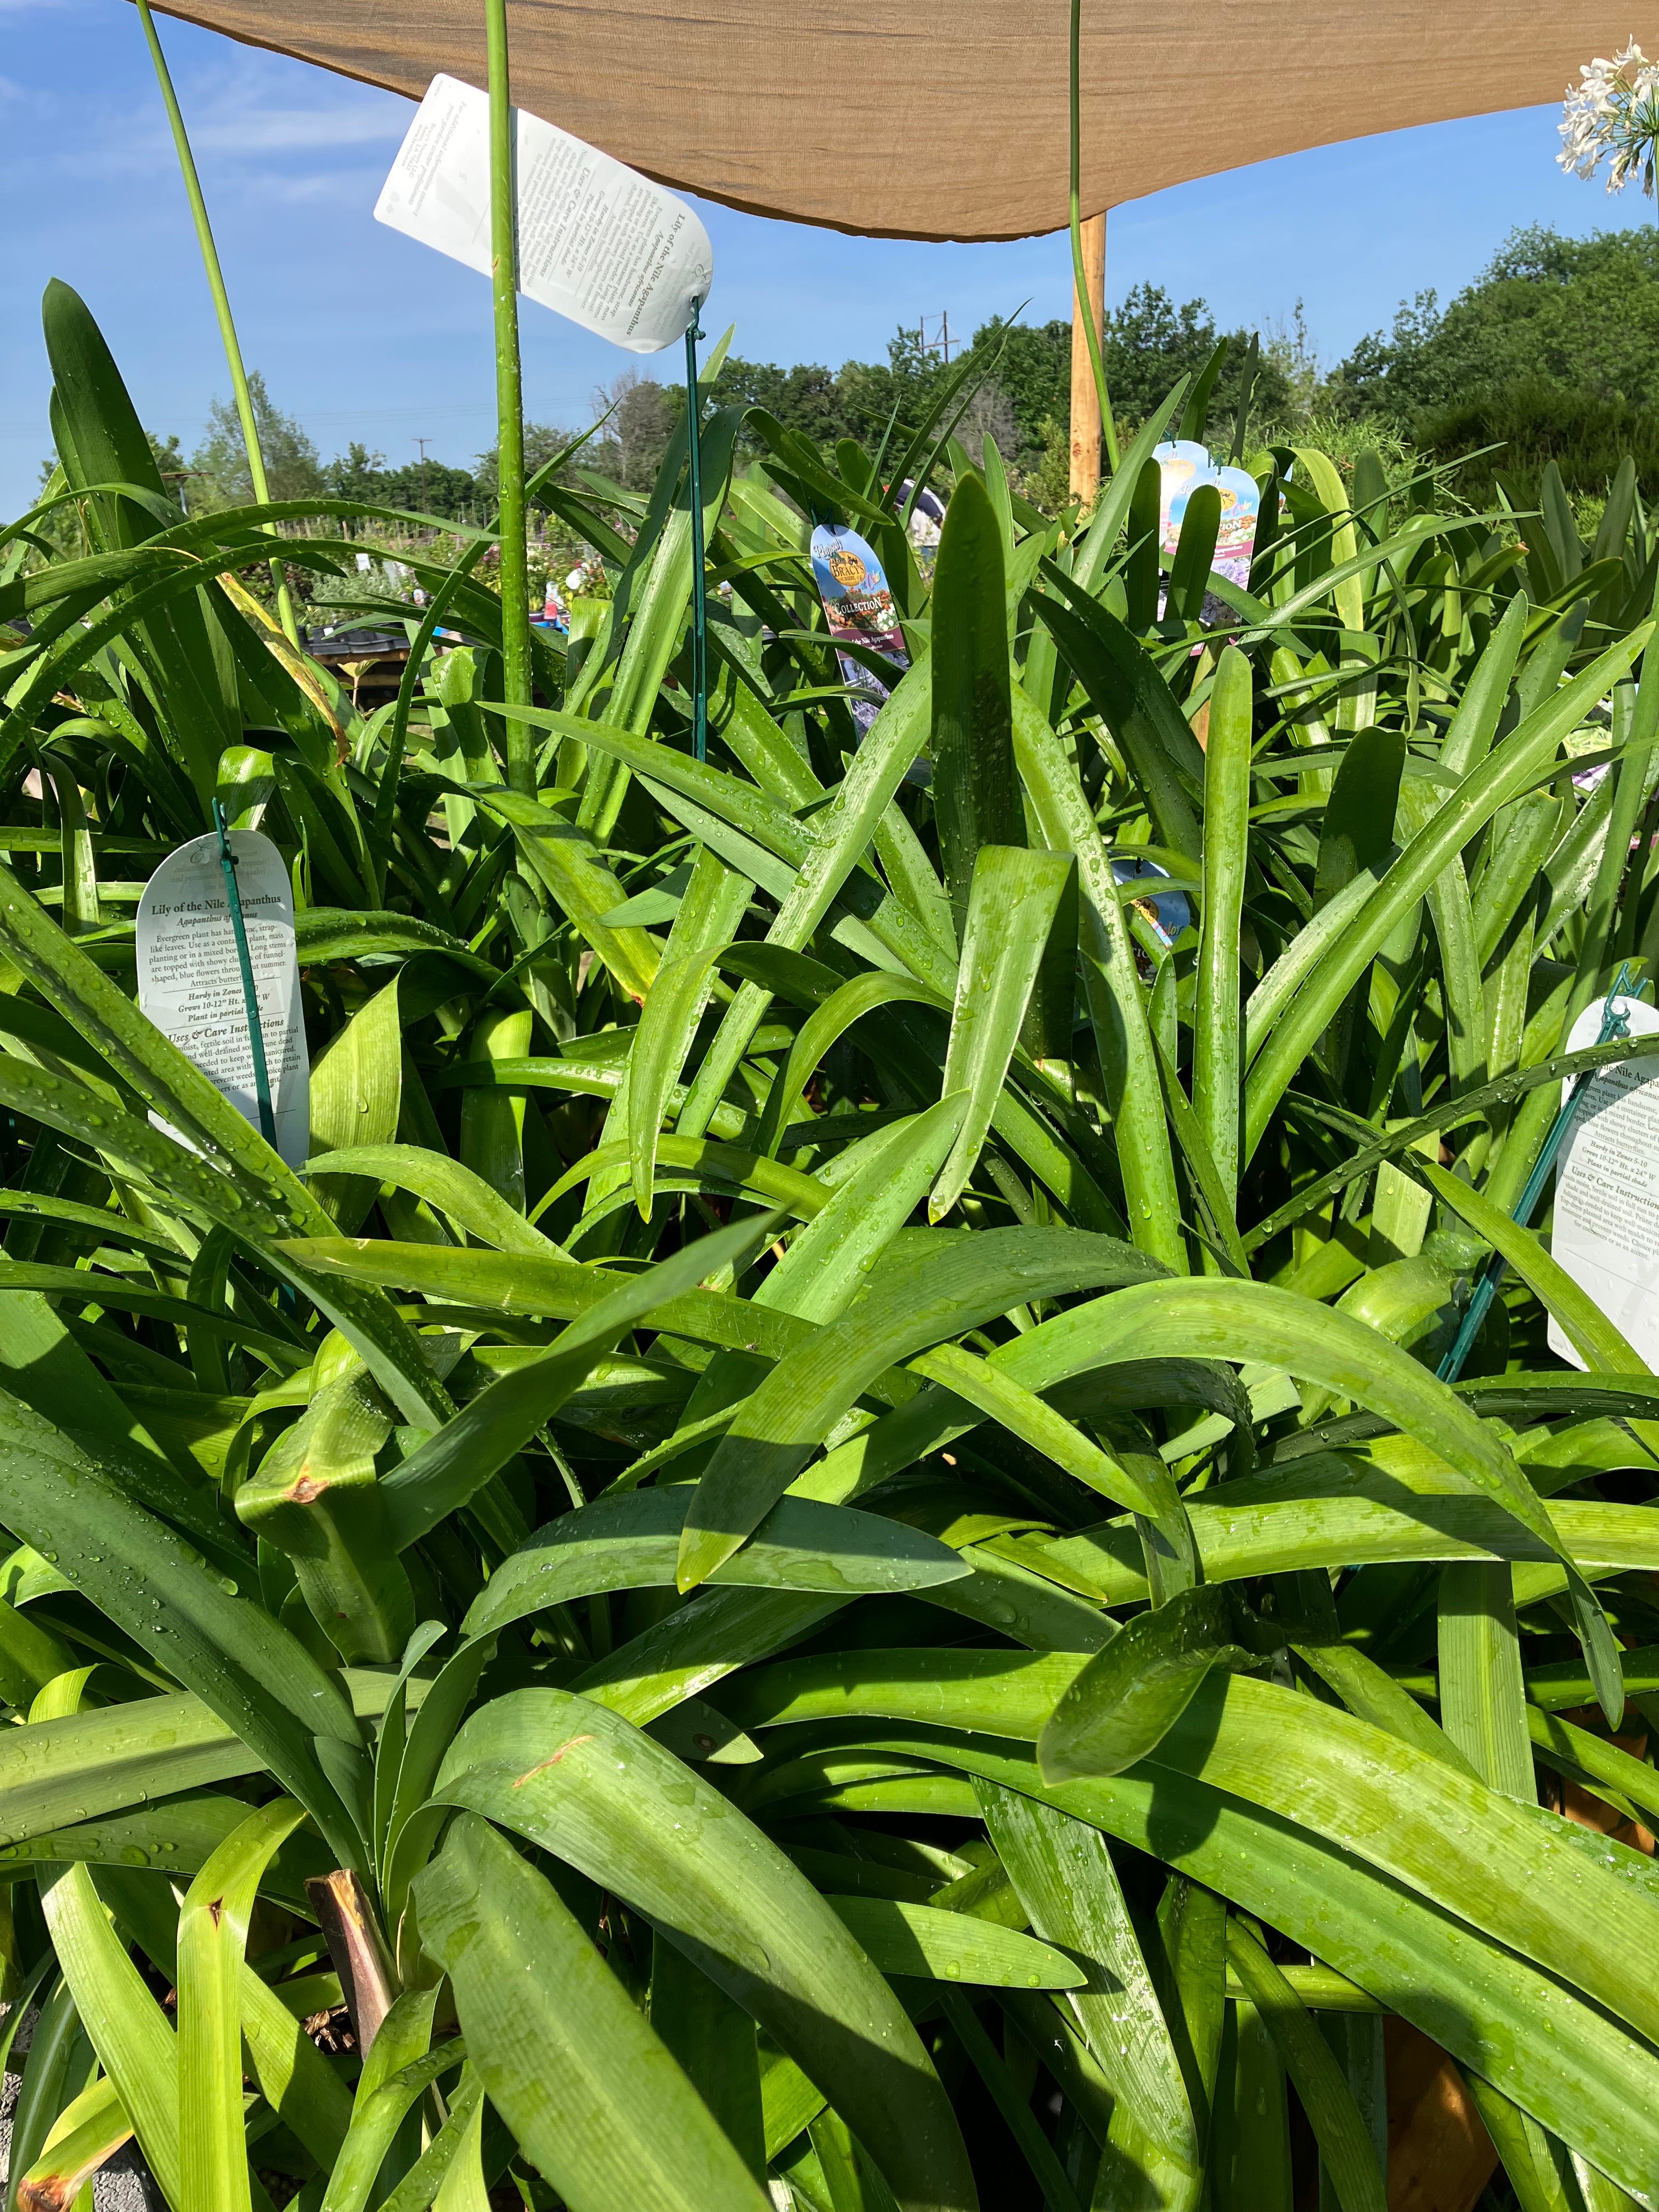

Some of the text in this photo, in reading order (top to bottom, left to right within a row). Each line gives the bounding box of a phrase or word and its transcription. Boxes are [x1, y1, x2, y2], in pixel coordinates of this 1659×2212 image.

[583, 193, 594, 213] Plant
[623, 184, 637, 206] shaped,
[635, 189, 651, 217] planting
[649, 196, 658, 208] like
[617, 208, 628, 223] blue
[627, 199, 639, 222] topped
[539, 167, 590, 277] Uses Care Instructions
[619, 223, 629, 236] with
[671, 213, 685, 232] Lily
[568, 221, 581, 247] partial
[577, 204, 608, 272] Hardy Zones 5-10
[607, 223, 620, 246] flowers
[634, 231, 644, 243] Use
[666, 234, 674, 246] of
[610, 237, 623, 258] showy
[619, 239, 630, 259] mixed
[659, 245, 670, 261] the
[591, 246, 610, 283] throughout
[600, 258, 613, 281] clusters
[610, 206, 662, 318] Evergreen plant has handsome, strap-
[616, 257, 630, 286] container
[628, 230, 663, 307] Agapanthus africanus
[650, 261, 664, 282] Nile
[600, 283, 612, 301] Long
[607, 285, 618, 303] plant,
[593, 301, 603, 318] stems
[601, 306, 610, 320] mass
[626, 282, 653, 335] Agapanthus
[832, 564, 865, 577] BRACY'S
[834, 597, 882, 615] COLLECTION
[150, 899, 225, 917] Lily of the Nile
[176, 911, 222, 928] Agapanthus
[156, 934, 190, 943] Evergreen
[191, 931, 209, 940] plant
[258, 923, 277, 932] strap-
[150, 944, 162, 953] like
[249, 934, 267, 944] plant,
[149, 954, 178, 965] planting
[203, 947, 224, 956] mixed
[163, 961, 188, 972] topped
[255, 952, 261, 960] of
[263, 950, 285, 958] funnel-
[151, 973, 178, 983] shaped,
[190, 979, 217, 987] Attracts
[188, 991, 211, 1000] Hardy
[188, 1013, 208, 1022] Plant
[219, 1007, 244, 1019] partial
[200, 1039, 221, 1048] fertile
[222, 1036, 234, 1045] soil
[279, 1026, 298, 1037] partial
[202, 1028, 227, 1037] Care
[198, 1036, 293, 1058] well-drained dead
[236, 1062, 251, 1071] with
[282, 1054, 301, 1064] retain
[281, 1064, 298, 1075] plant
[1613, 1065, 1632, 1078] Nile
[1599, 1096, 1647, 1119] Use container
[1601, 1090, 1657, 1115] plant handsome,
[1609, 1110, 1625, 1120] mixed
[1596, 1113, 1648, 1138] with showy clusters
[1600, 1123, 1618, 1136] flowers
[1620, 1132, 1652, 1148] throughout
[1582, 1147, 1598, 1158] Grows
[1590, 1140, 1647, 1167] Hardy Zones 5-10
[1572, 1165, 1614, 1190] Uses Care
[1587, 1158, 1647, 1187] Plant partial shade
[1635, 1212, 1652, 1226] Prune
